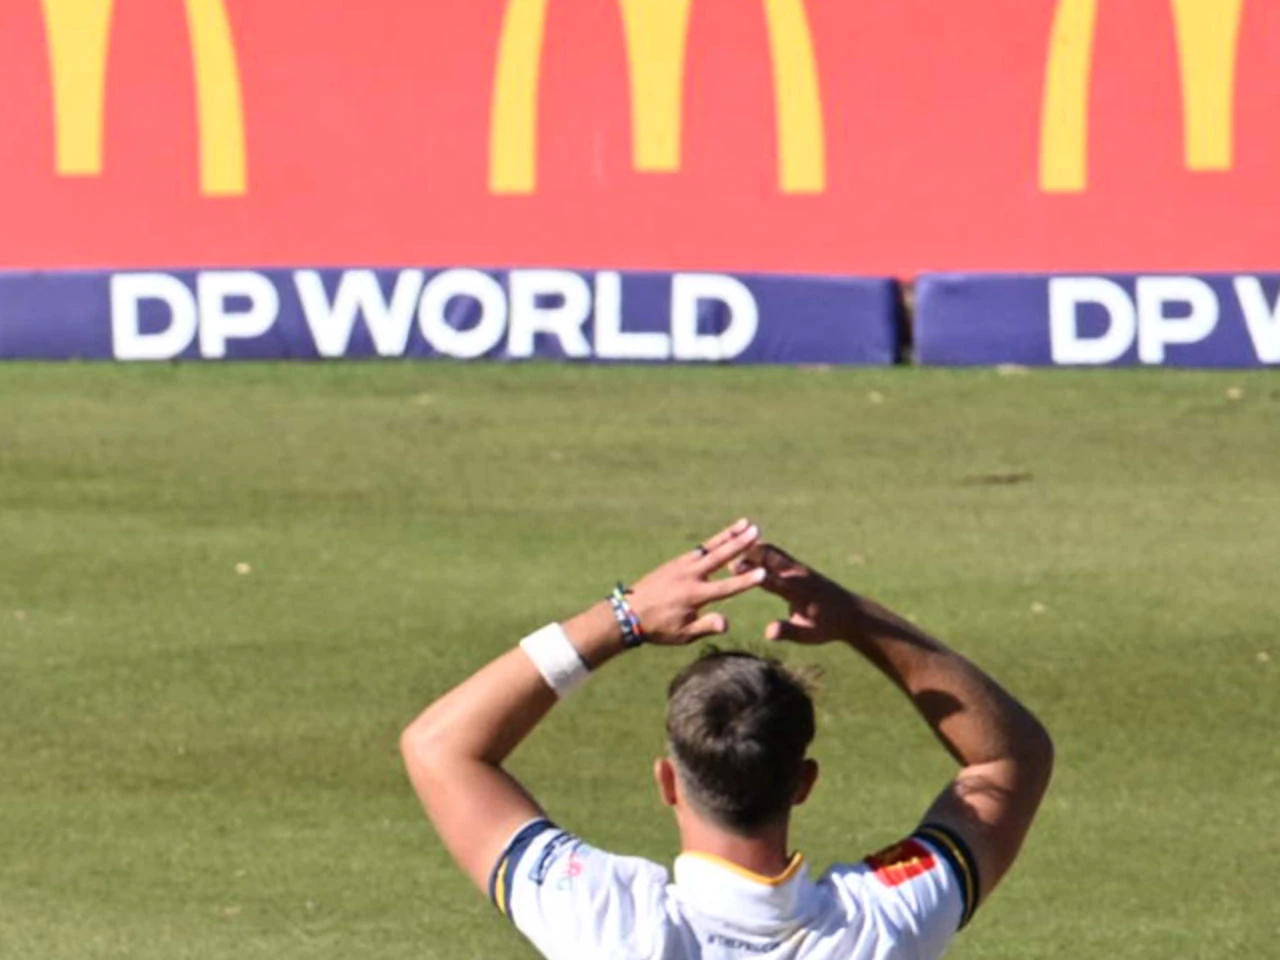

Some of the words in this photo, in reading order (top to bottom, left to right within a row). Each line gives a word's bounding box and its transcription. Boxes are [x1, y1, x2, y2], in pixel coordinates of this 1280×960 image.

[109, 270, 280, 361] DP
[292, 267, 759, 360] WORLD
[1047, 275, 1220, 365] DP
